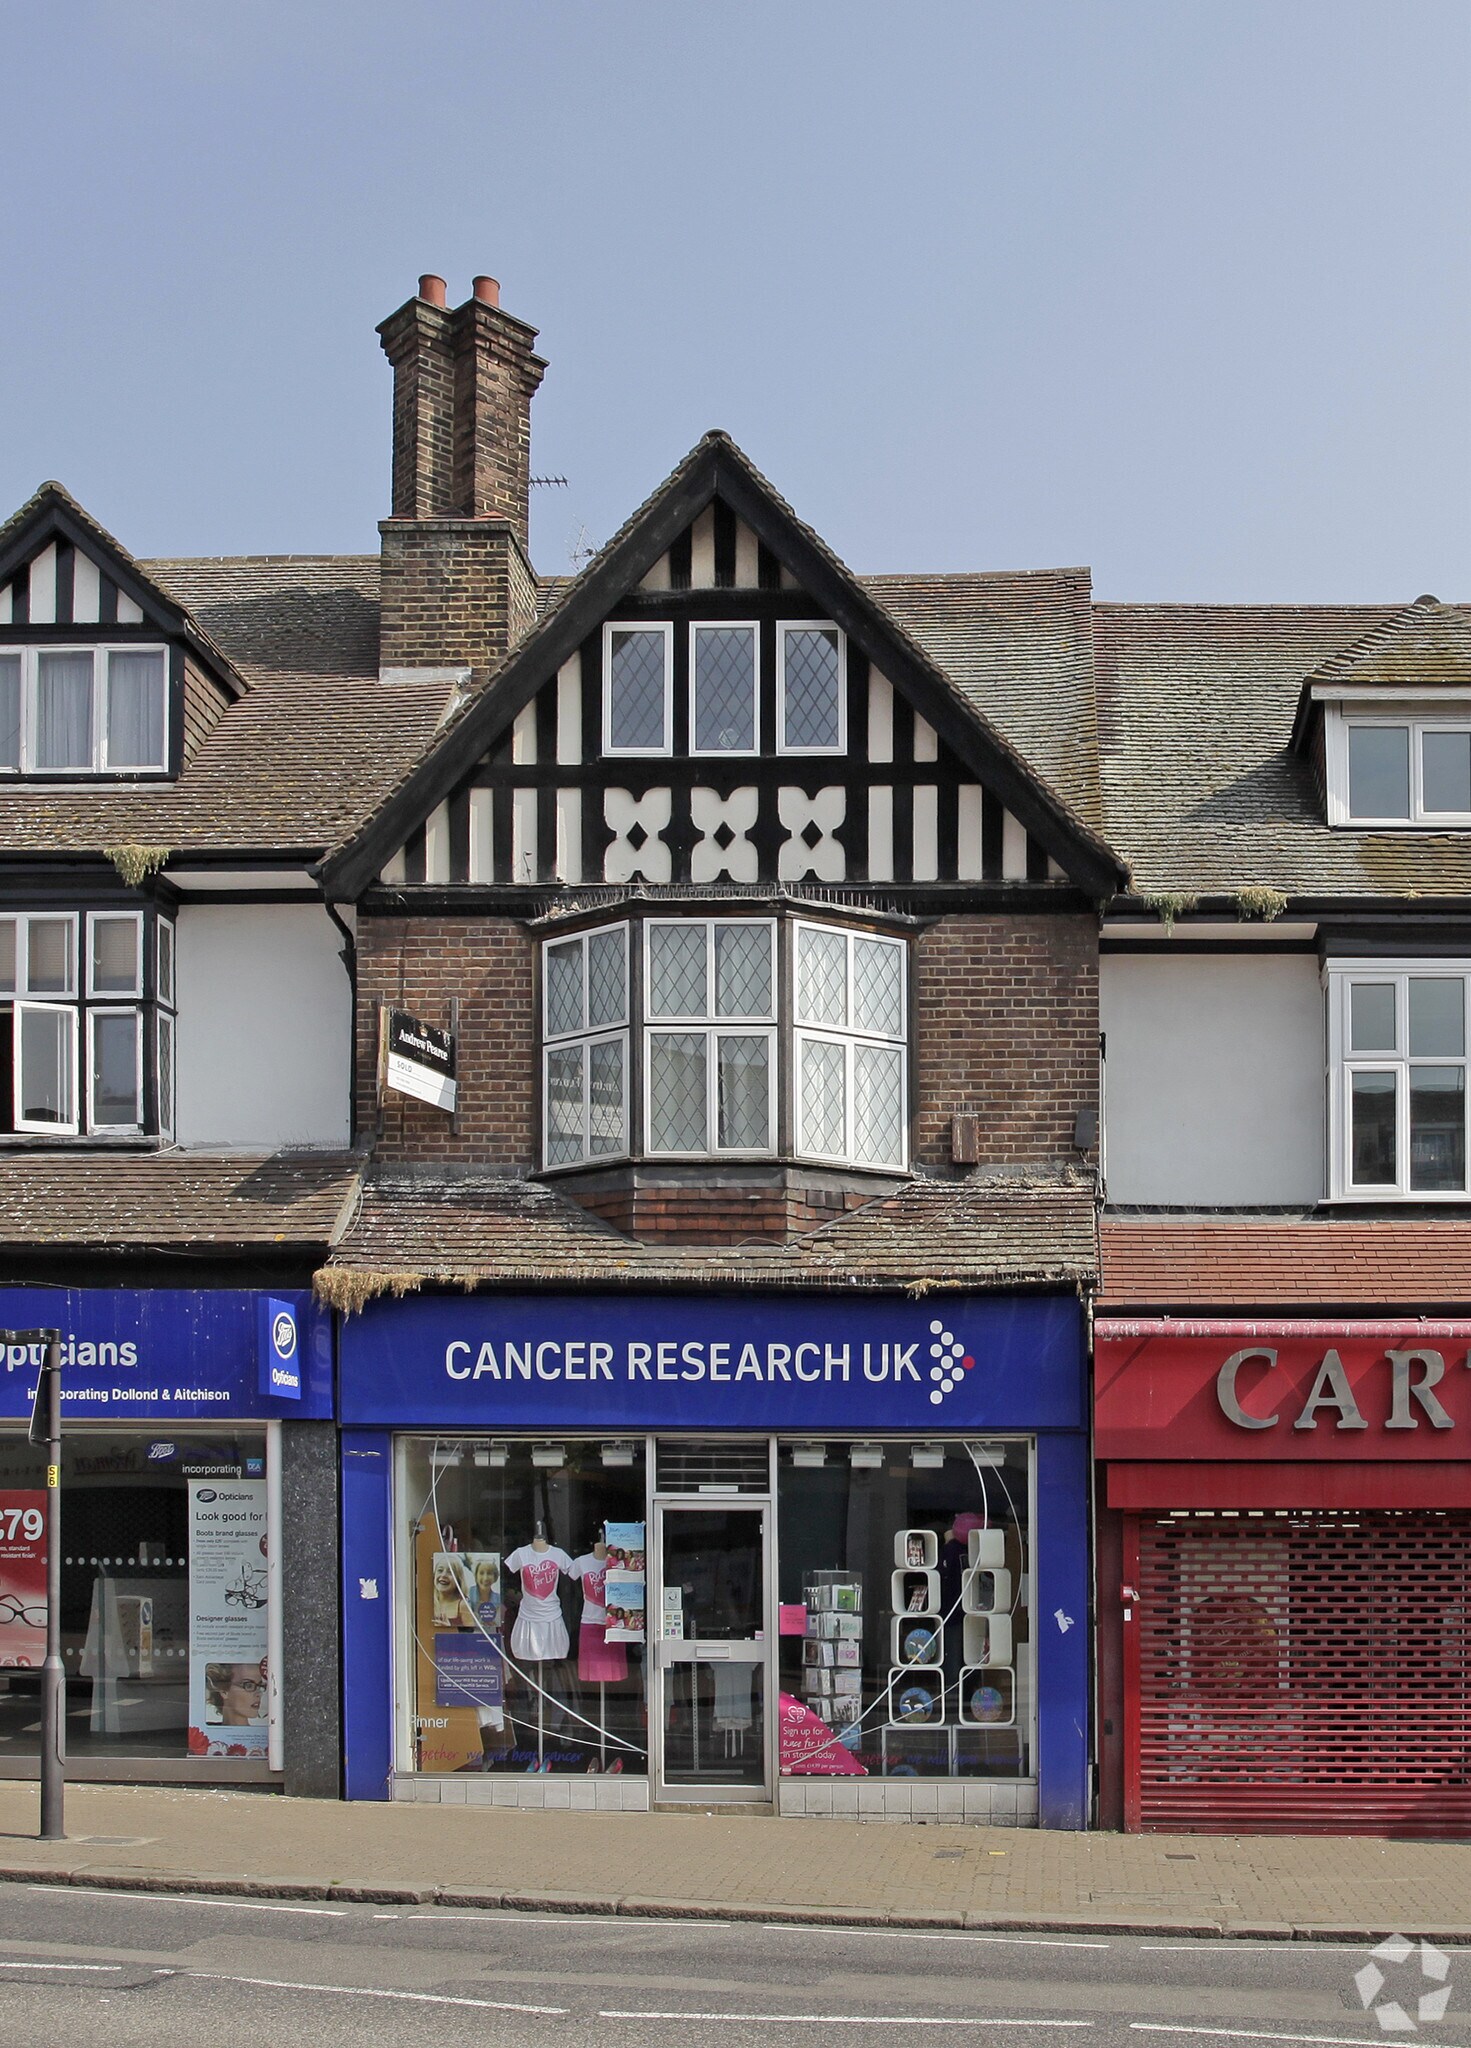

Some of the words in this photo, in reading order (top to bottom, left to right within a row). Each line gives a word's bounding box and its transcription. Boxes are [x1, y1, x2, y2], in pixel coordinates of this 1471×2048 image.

[399, 1029, 426, 1050] Andrew
[427, 1040, 448, 1060] Pearce
[397, 1061, 412, 1073] SOLD
[445, 1341, 614, 1380] CANCER
[627, 1342, 850, 1381] RESEARCH
[862, 1343, 921, 1381] UK
[272, 1366, 299, 1387] Opticians
[112, 1388, 158, 1401] Dollond
[162, 1389, 171, 1401] &
[174, 1388, 230, 1401] Aitchison
[1217, 1347, 1471, 1430] CAR
[148, 1443, 175, 1459] Boots
[49, 1466, 56, 1476] S
[182, 1464, 242, 1476] incorporating
[49, 1476, 56, 1486] 6
[219, 1492, 254, 1501] Opticians
[196, 1512, 220, 1521] Look
[222, 1512, 247, 1522] good
[250, 1512, 263, 1521] for
[0, 1508, 44, 1541] 79
[196, 1529, 214, 1537] Boots
[216, 1529, 234, 1537] brand
[235, 1530, 258, 1538] glasses
[528, 1561, 552, 1578] Race
[588, 1571, 607, 1585] Rac
[196, 1615, 223, 1624] Designer
[225, 1615, 248, 1624] glasses
[783, 1727, 799, 1738] Sign
[801, 1729, 811, 1738] up
[813, 1727, 824, 1736] for
